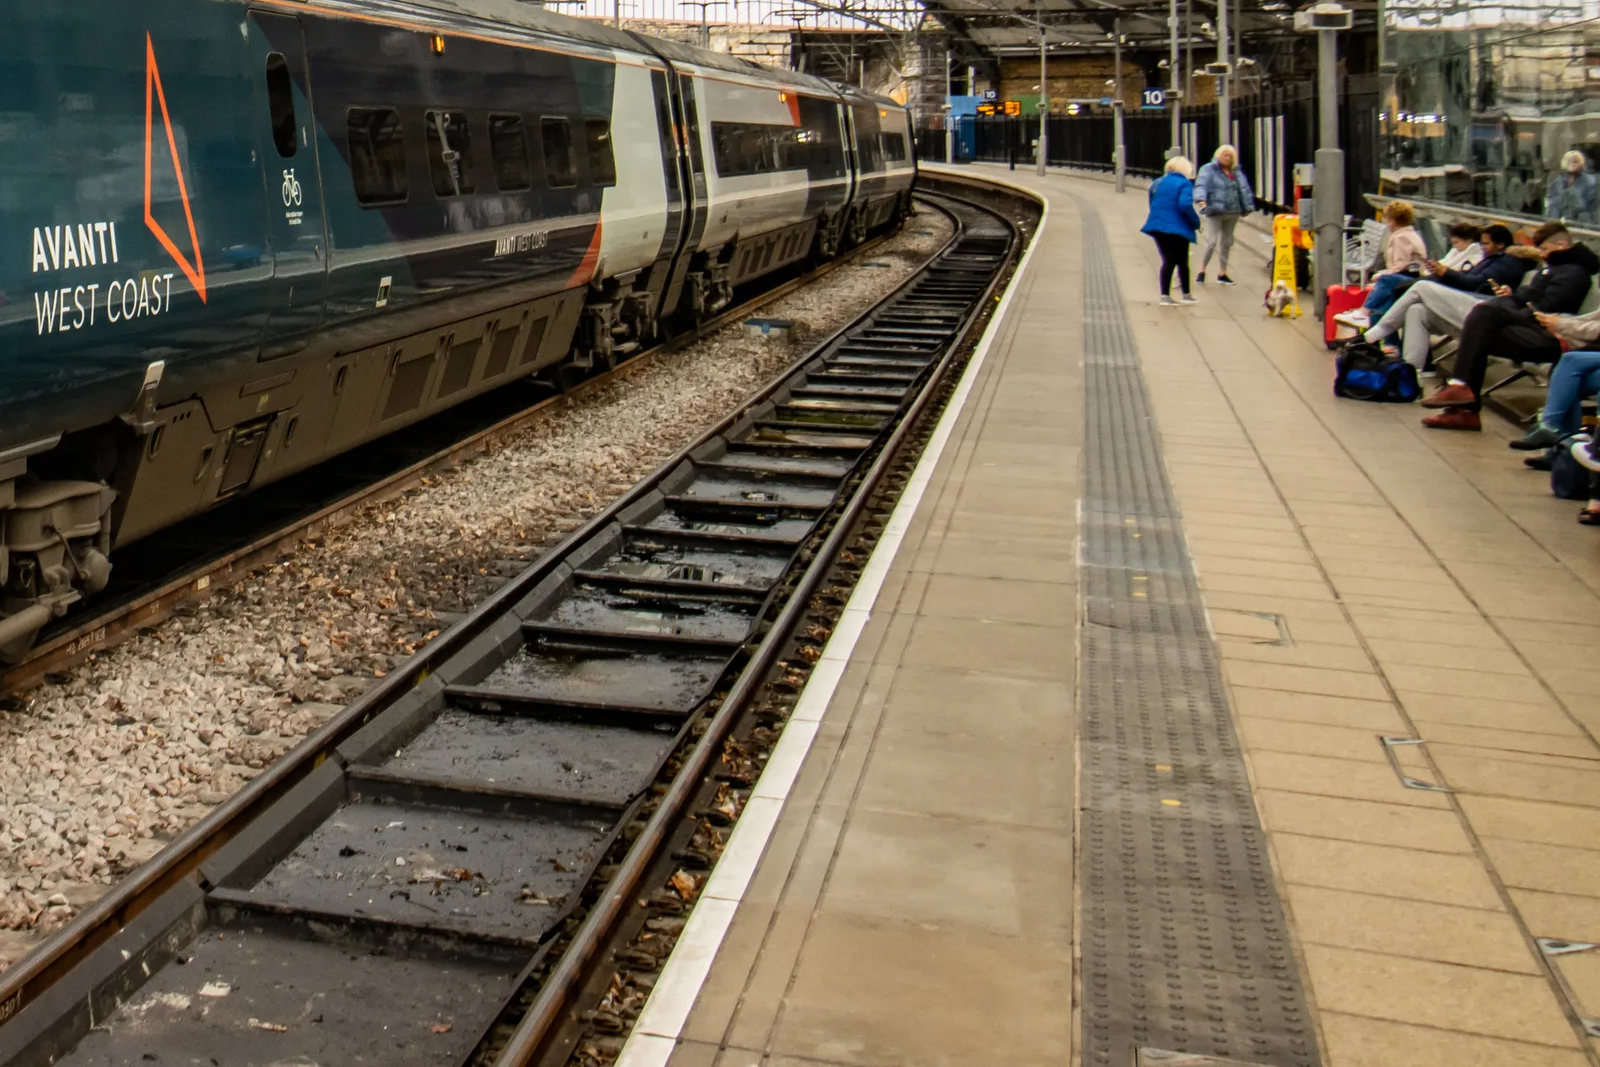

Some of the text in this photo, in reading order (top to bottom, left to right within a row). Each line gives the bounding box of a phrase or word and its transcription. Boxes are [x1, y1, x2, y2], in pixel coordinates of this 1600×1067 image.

[1143, 90, 1162, 104] 10
[32, 221, 118, 273] AVANTI
[494, 230, 548, 257] AVANTI WEST COAST
[34, 273, 174, 335] WEST COAST
